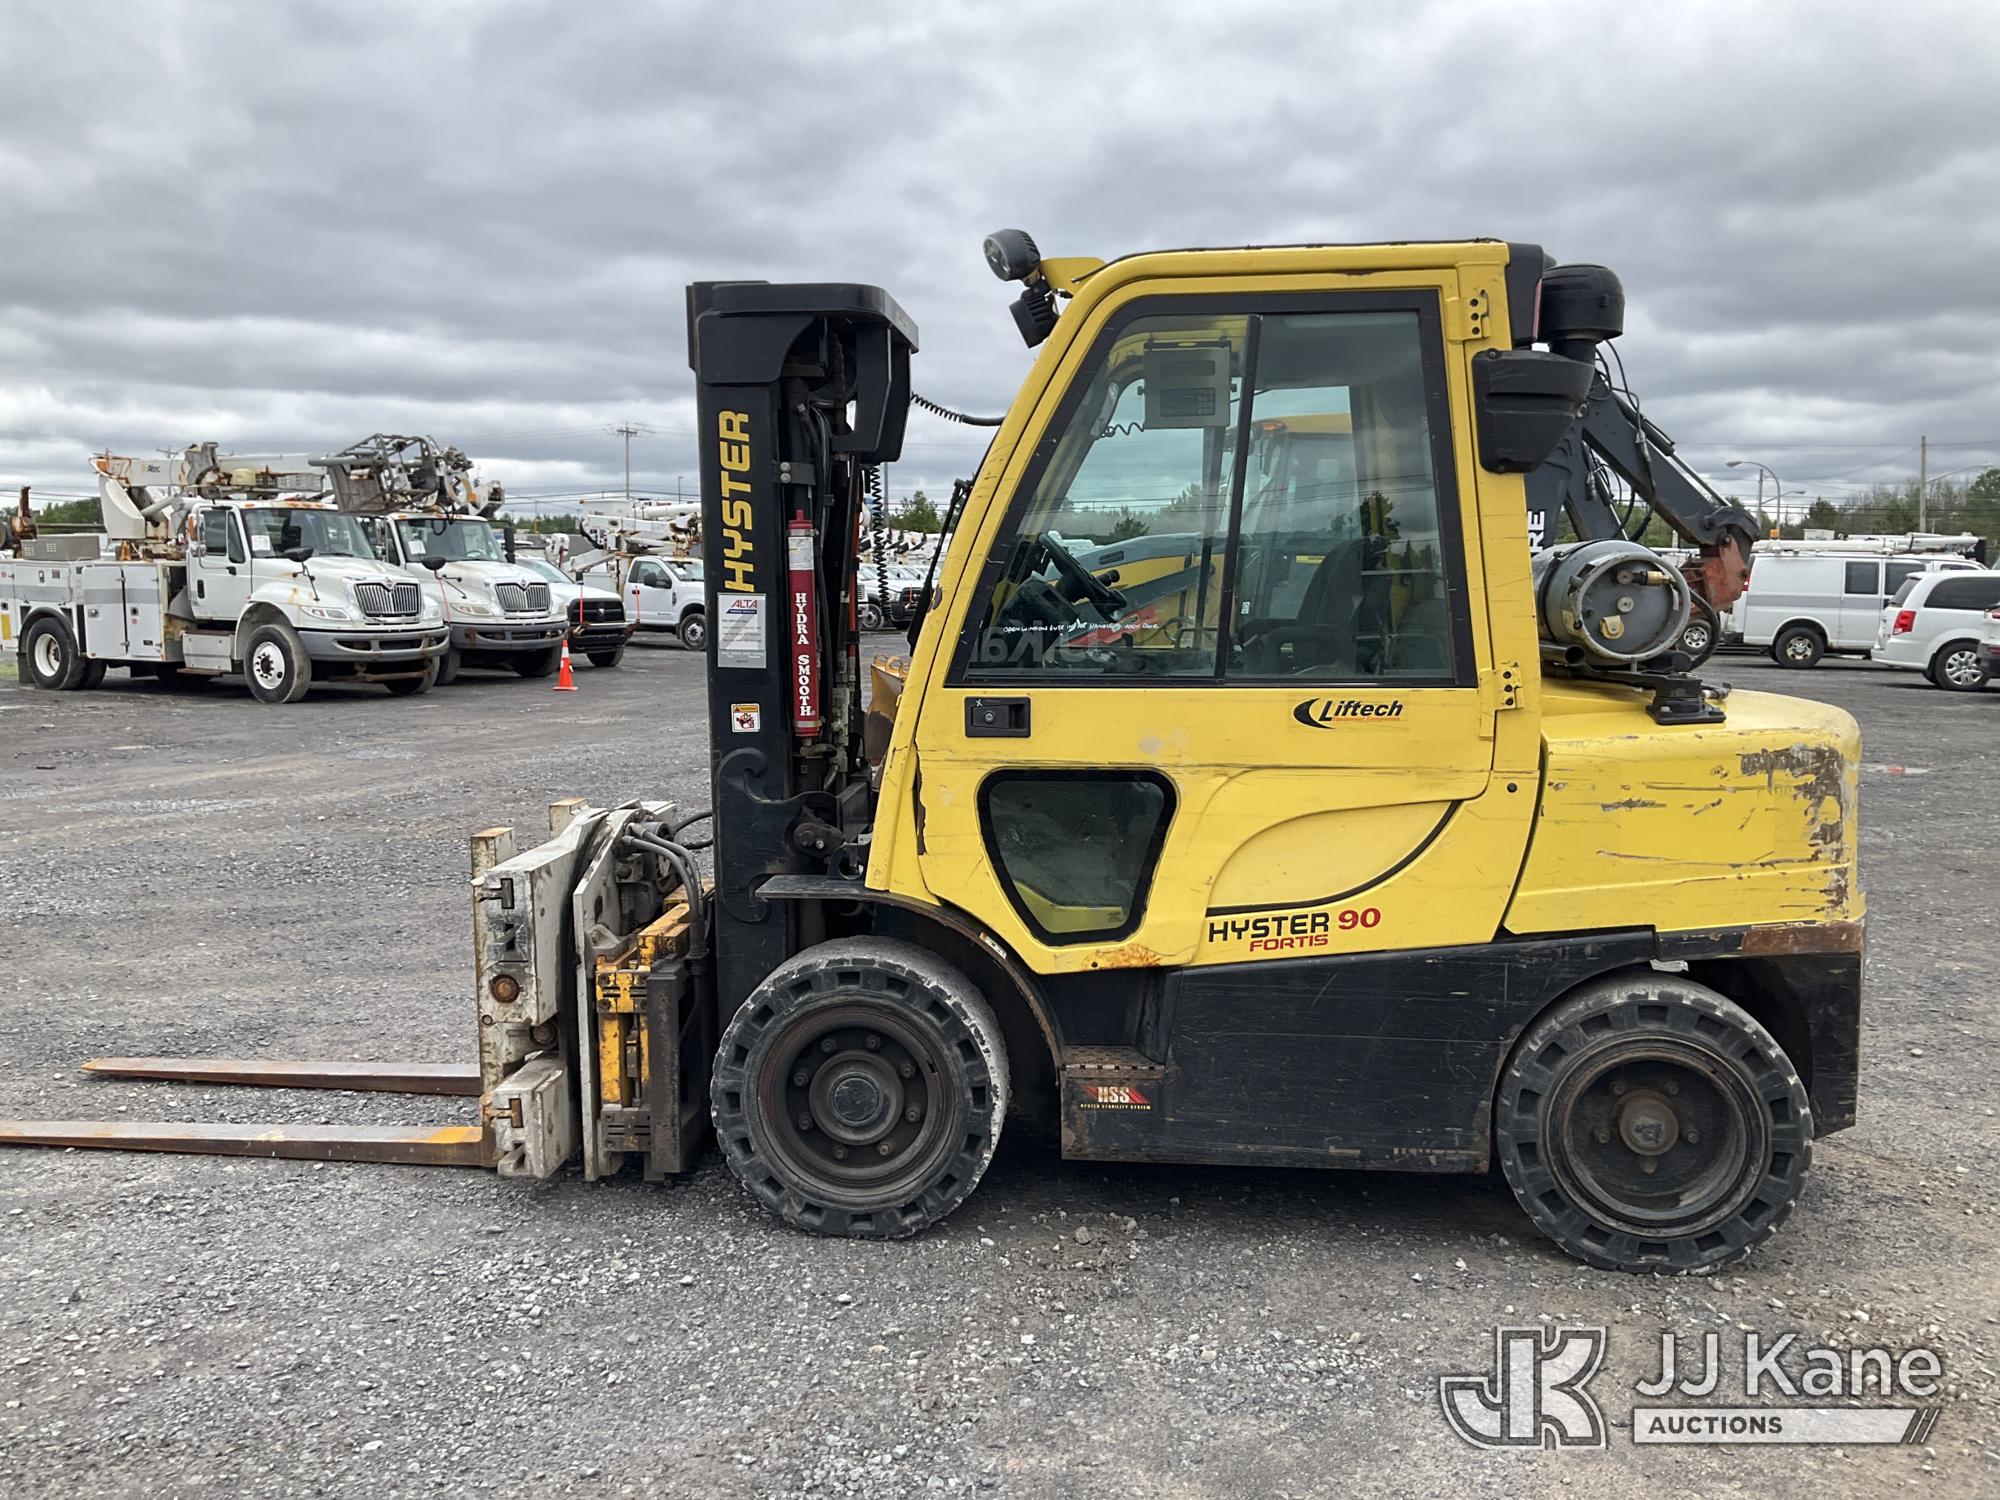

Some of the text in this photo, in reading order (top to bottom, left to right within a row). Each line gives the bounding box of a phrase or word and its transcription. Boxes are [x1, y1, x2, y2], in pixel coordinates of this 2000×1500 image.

[718, 410, 755, 592] HYSTER
[731, 599, 758, 609] ALTA
[795, 592, 812, 717] HYDRA SMOOTH
[1318, 700, 1403, 722] Liftech
[1208, 907, 1381, 943] HYSTER 90
[1249, 933, 1329, 952] FORTIS
[1097, 1086, 1130, 1104] HSS
